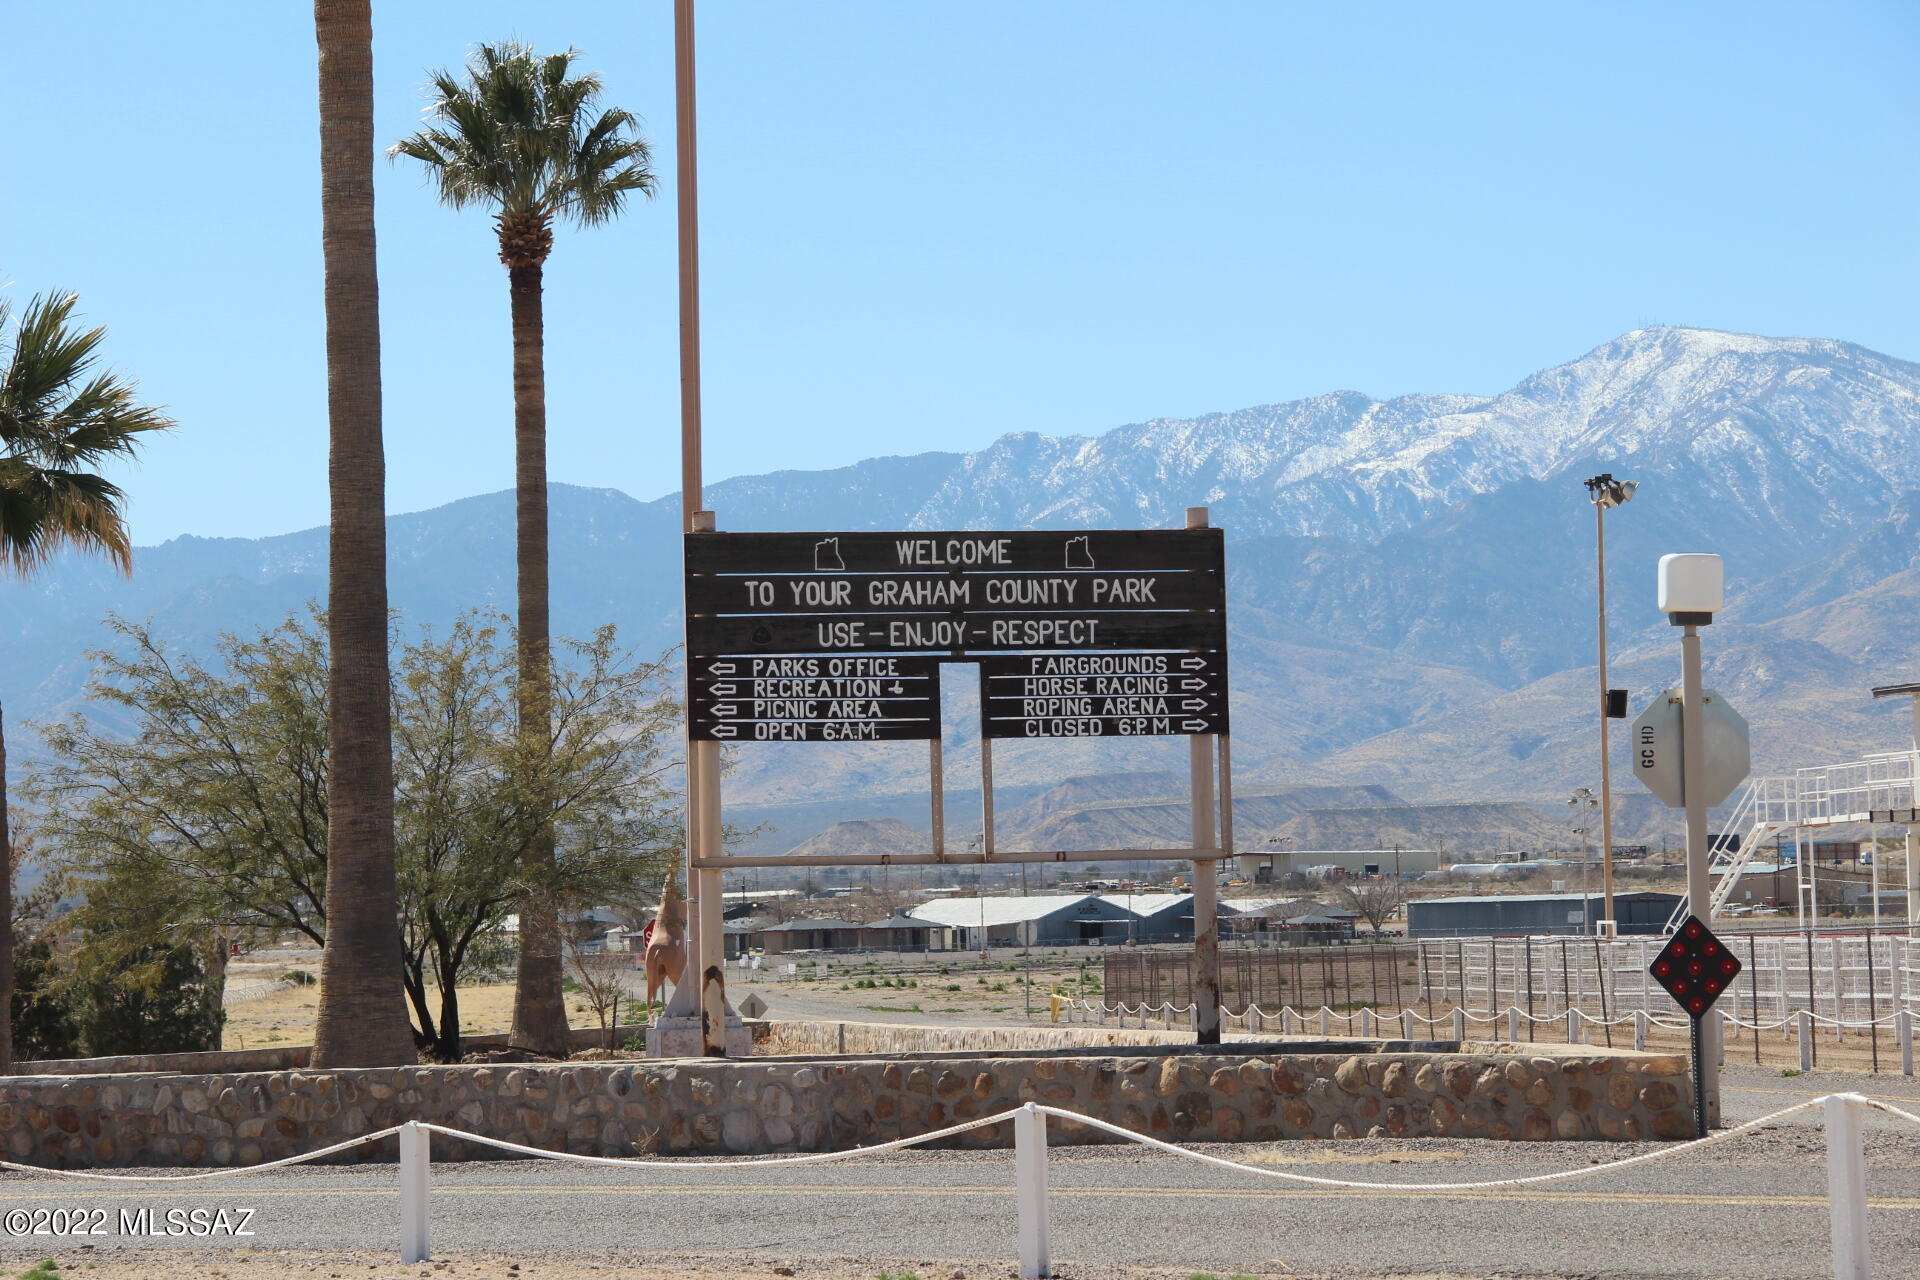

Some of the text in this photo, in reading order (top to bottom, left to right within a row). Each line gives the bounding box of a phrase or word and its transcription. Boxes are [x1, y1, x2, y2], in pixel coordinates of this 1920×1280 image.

[896, 540, 1012, 564] WELCOME
[745, 578, 1156, 606] TO YOUR GRAHAM COUNTY PARK
[753, 659, 899, 676] PARKS OFFICE
[1032, 656, 1167, 674] FAIRGROUNDS
[754, 680, 880, 697] RECREATION
[1024, 677, 1168, 696] HORSE RACING
[754, 701, 882, 718] PICNIC AREA
[1024, 698, 1168, 716] ROPING ARENA
[755, 722, 806, 740] OPEN
[1025, 719, 1103, 737] CLOSED
